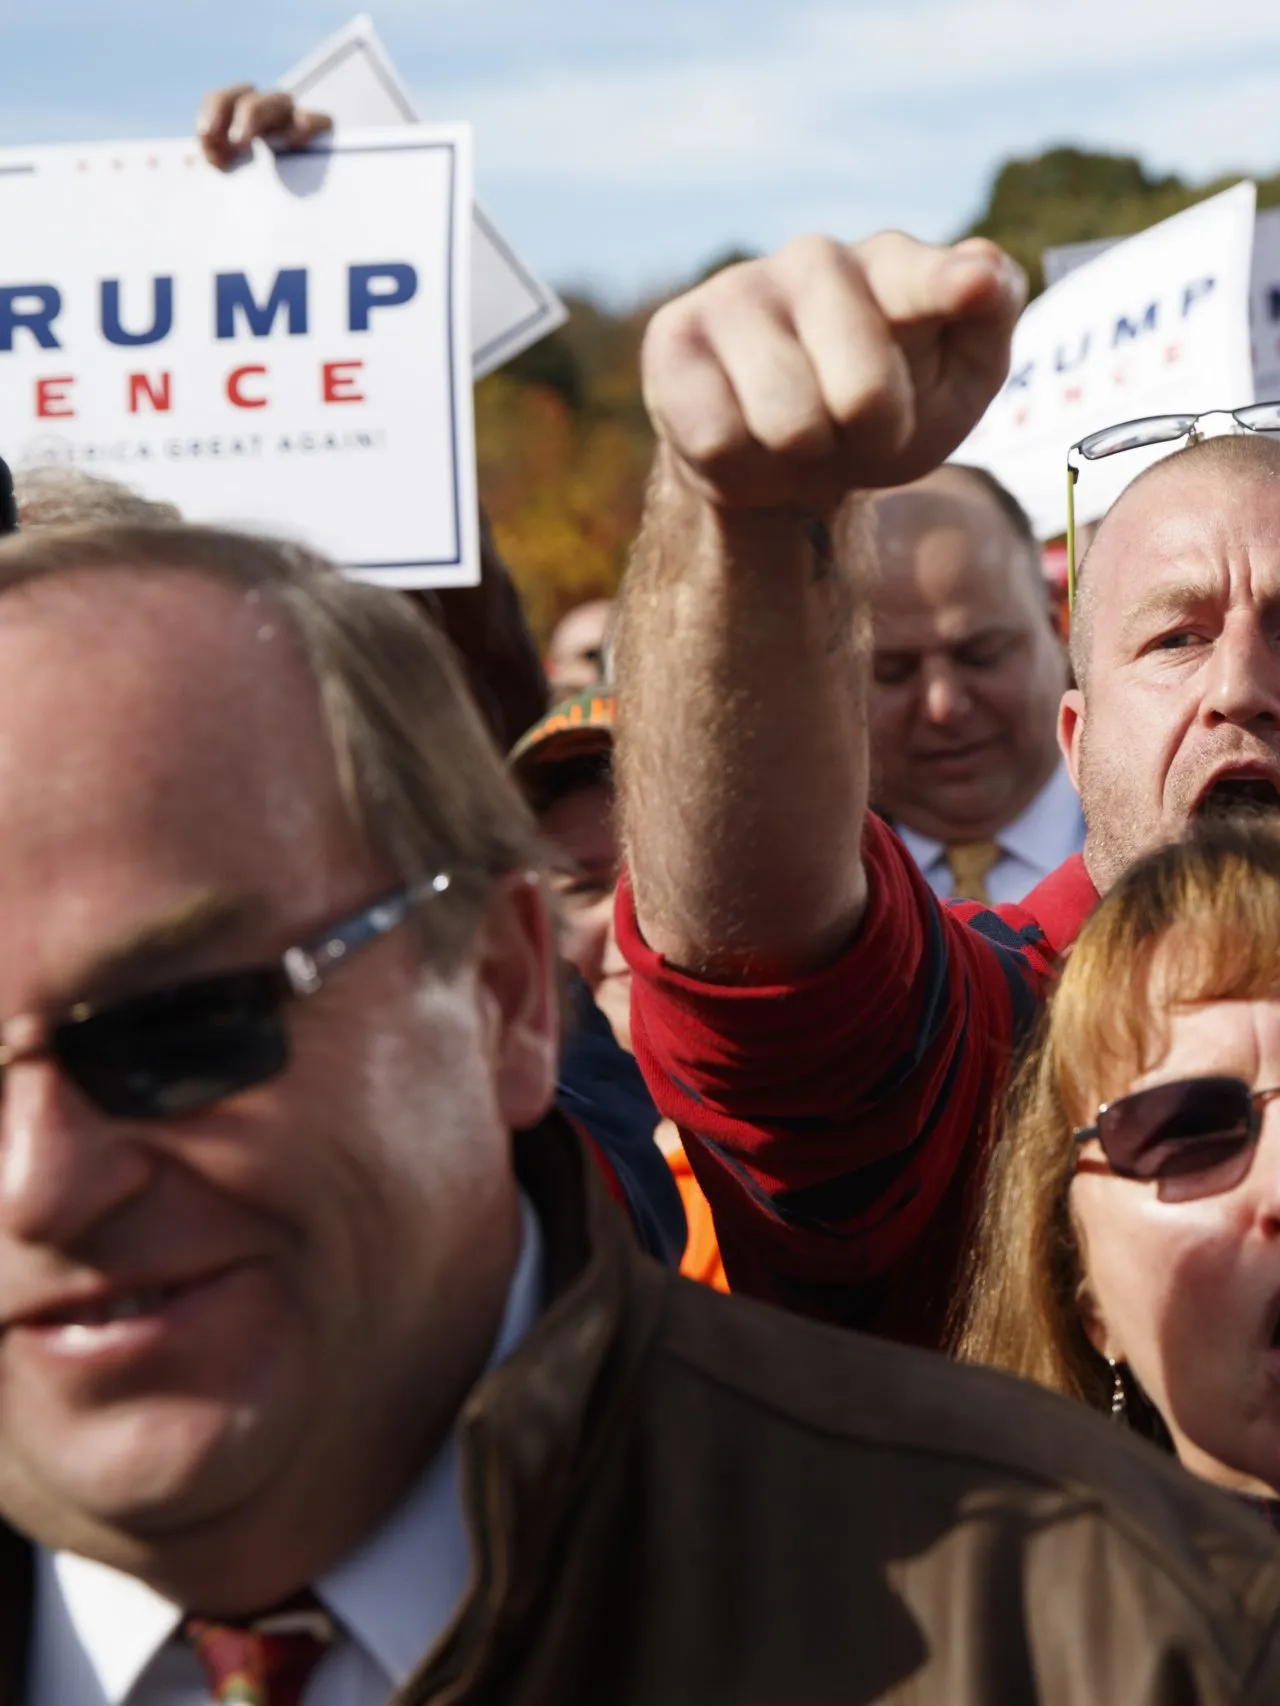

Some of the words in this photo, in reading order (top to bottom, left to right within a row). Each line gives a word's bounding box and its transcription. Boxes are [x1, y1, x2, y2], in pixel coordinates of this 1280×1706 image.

[0, 263, 418, 352] RUMP
[1004, 275, 1217, 396] RUMP
[36, 360, 365, 418] ENCE
